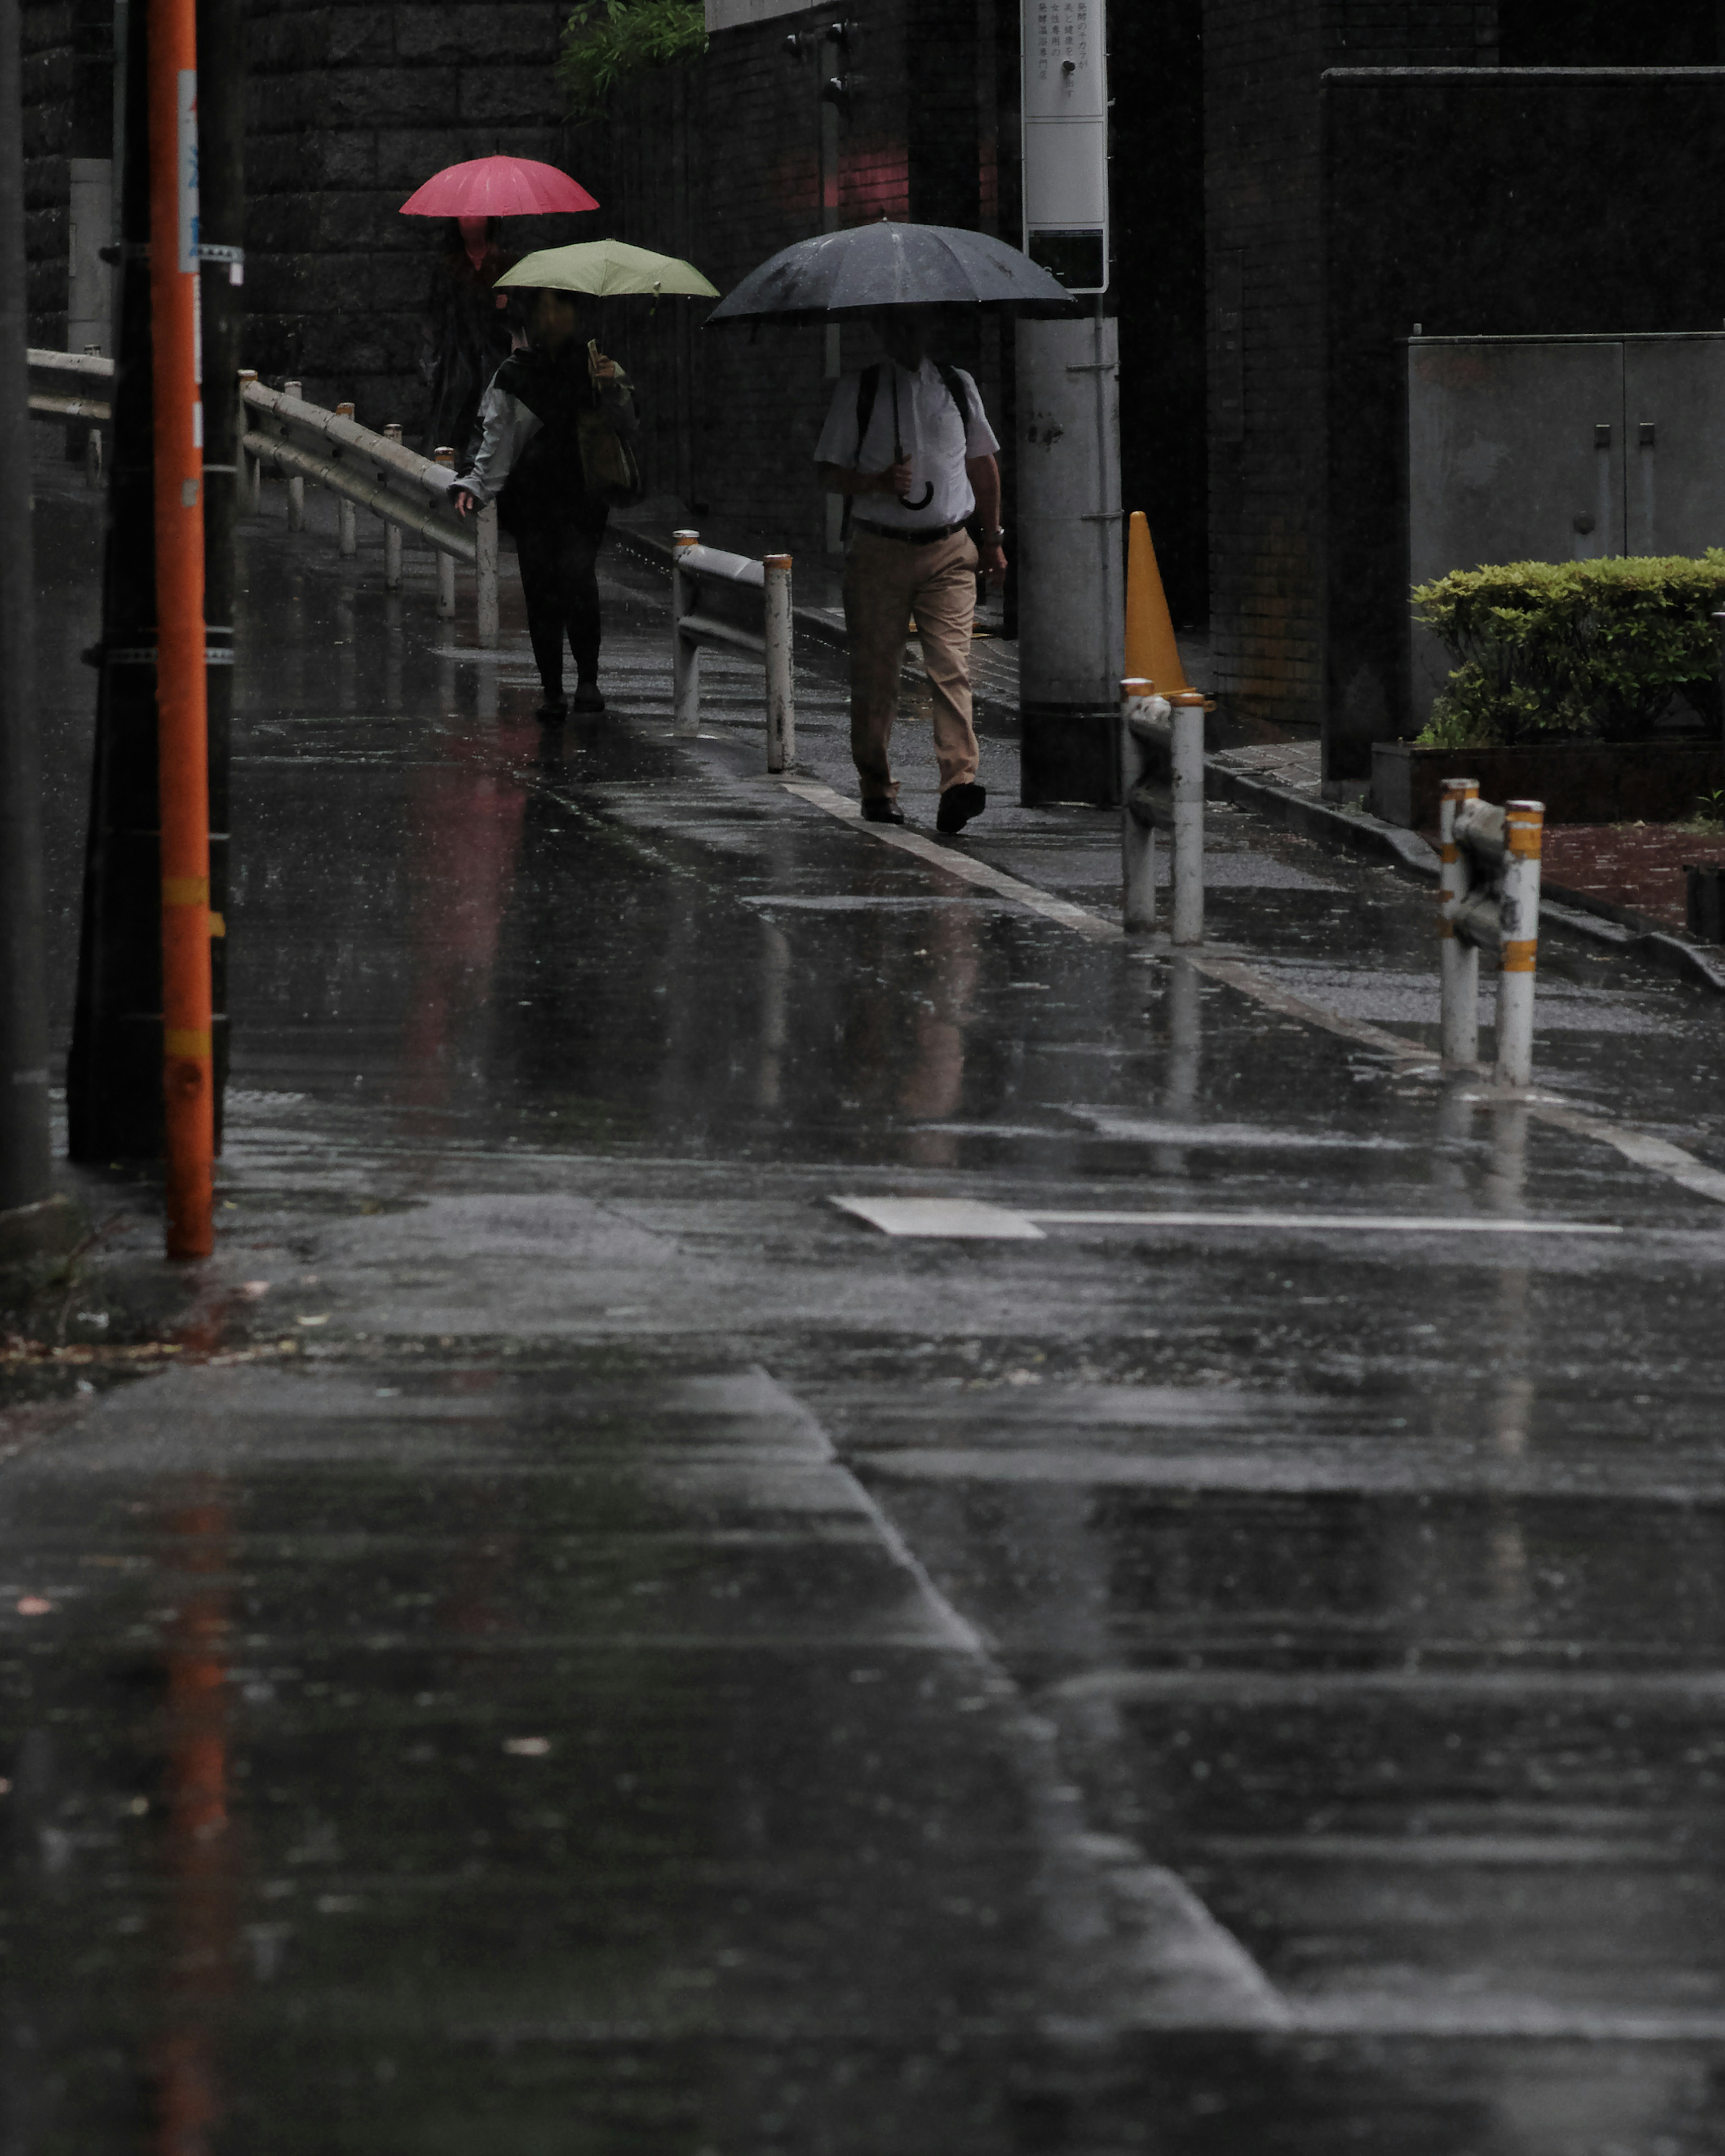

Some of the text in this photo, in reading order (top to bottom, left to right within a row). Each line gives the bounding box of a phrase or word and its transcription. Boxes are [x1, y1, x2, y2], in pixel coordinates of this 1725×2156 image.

[1051, 4, 1061, 56] 女性専用の
[1064, 3, 1074, 98] 美と健康を出す
[1078, 2, 1088, 69] 発酵のチカラが
